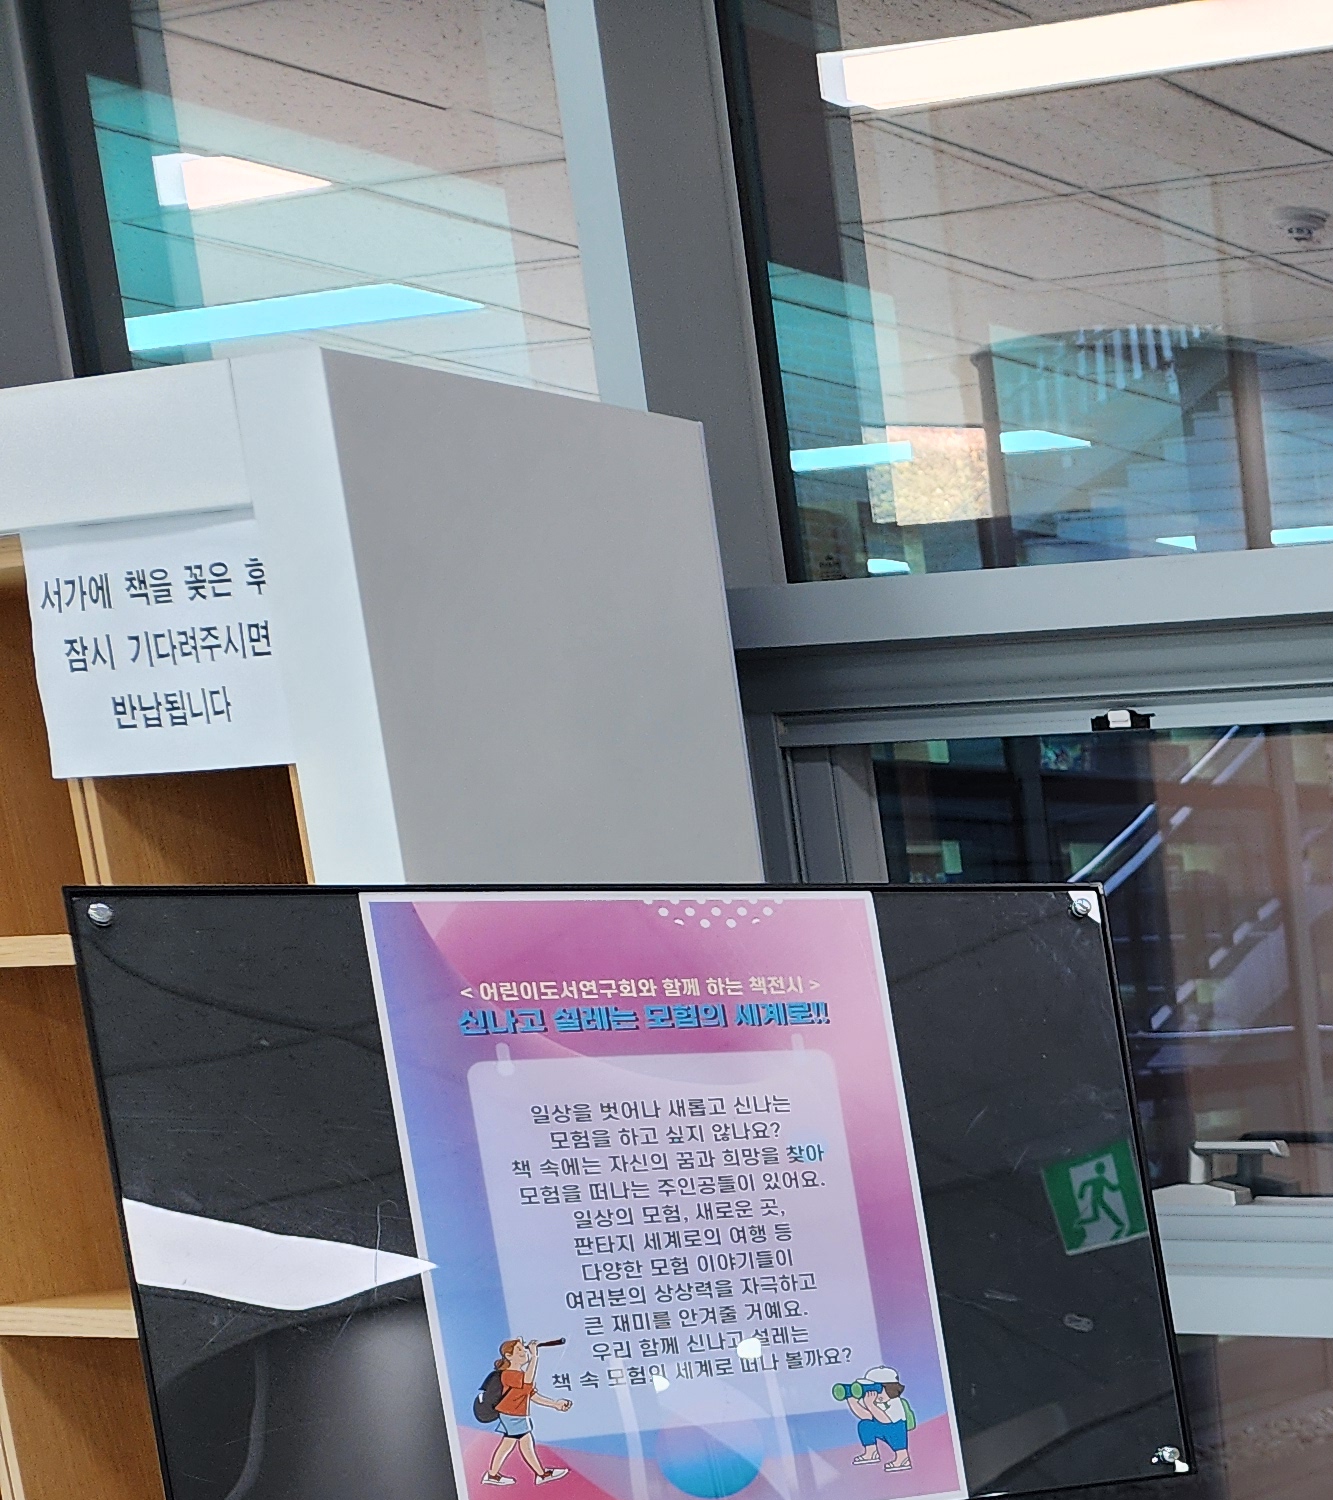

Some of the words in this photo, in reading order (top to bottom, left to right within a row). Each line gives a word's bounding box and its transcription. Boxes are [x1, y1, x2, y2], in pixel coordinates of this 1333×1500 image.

[41, 573, 112, 613] 서가에
[125, 568, 172, 605] 책을
[245, 558, 266, 595] 후
[64, 634, 115, 672] 잠시
[127, 620, 272, 667] 기다려주시면
[112, 686, 231, 729] 반납됩니다
[480, 977, 657, 1002] 어린이도서연구회와
[662, 977, 700, 997] 함께
[706, 978, 743, 996] 하는
[749, 975, 804, 995] 책전시
[459, 1009, 548, 1036] 신나고
[554, 1006, 638, 1032] 설레는
[644, 1004, 728, 1030] 모험의
[531, 1104, 592, 1124] 일상을
[600, 1100, 661, 1121] 벗어나
[669, 1098, 726, 1117] 새롭고
[734, 1095, 790, 1114] 신나는
[550, 1130, 611, 1149] 모험을
[618, 1128, 658, 1146] 하고
[666, 1125, 704, 1144] 싶지
[712, 1122, 780, 1142] 않나요?
[512, 1160, 531, 1178] 책
[540, 1157, 601, 1177] 속에는
[608, 1153, 668, 1172] 자신의
[676, 1150, 715, 1169] 꿈과
[722, 1147, 779, 1166] 희망을
[786, 1144, 824, 1163] 찾아
[520, 1185, 582, 1205] 모험을
[589, 1181, 650, 1200] 떠나는
[658, 1174, 755, 1197] 주인공들이
[763, 1171, 825, 1190] 있어요.
[574, 1208, 634, 1229] 일상의
[642, 1205, 688, 1223] 모험,
[696, 1200, 753, 1220] 새로운
[760, 1199, 785, 1217] 곳,
[574, 1234, 635, 1256] 판타지
[644, 1228, 721, 1250] 세계로의
[730, 1225, 767, 1244] 여행
[775, 1224, 792, 1241] 등
[582, 1260, 643, 1281] 다양한
[651, 1257, 689, 1276] 모험
[698, 1249, 793, 1272] 이야기들이
[566, 1286, 646, 1309] 여러분의
[654, 1280, 733, 1302] 상상력을
[740, 1273, 817, 1294] 자극하고
[584, 1317, 604, 1335] 큰
[611, 1311, 671, 1332] 재미를
[679, 1305, 737, 1327] 안겨줄
[745, 1301, 808, 1320] 거예요.
[593, 1341, 632, 1361] 우리
[639, 1336, 679, 1357] 함께
[687, 1331, 743, 1352] 신나고
[750, 1326, 808, 1346] 설레는
[552, 1373, 572, 1391] 책
[580, 1371, 599, 1388] 속
[676, 1358, 734, 1379] 세계로
[740, 1353, 779, 1372] 떠나
[786, 1348, 851, 1369] 볼까요?
